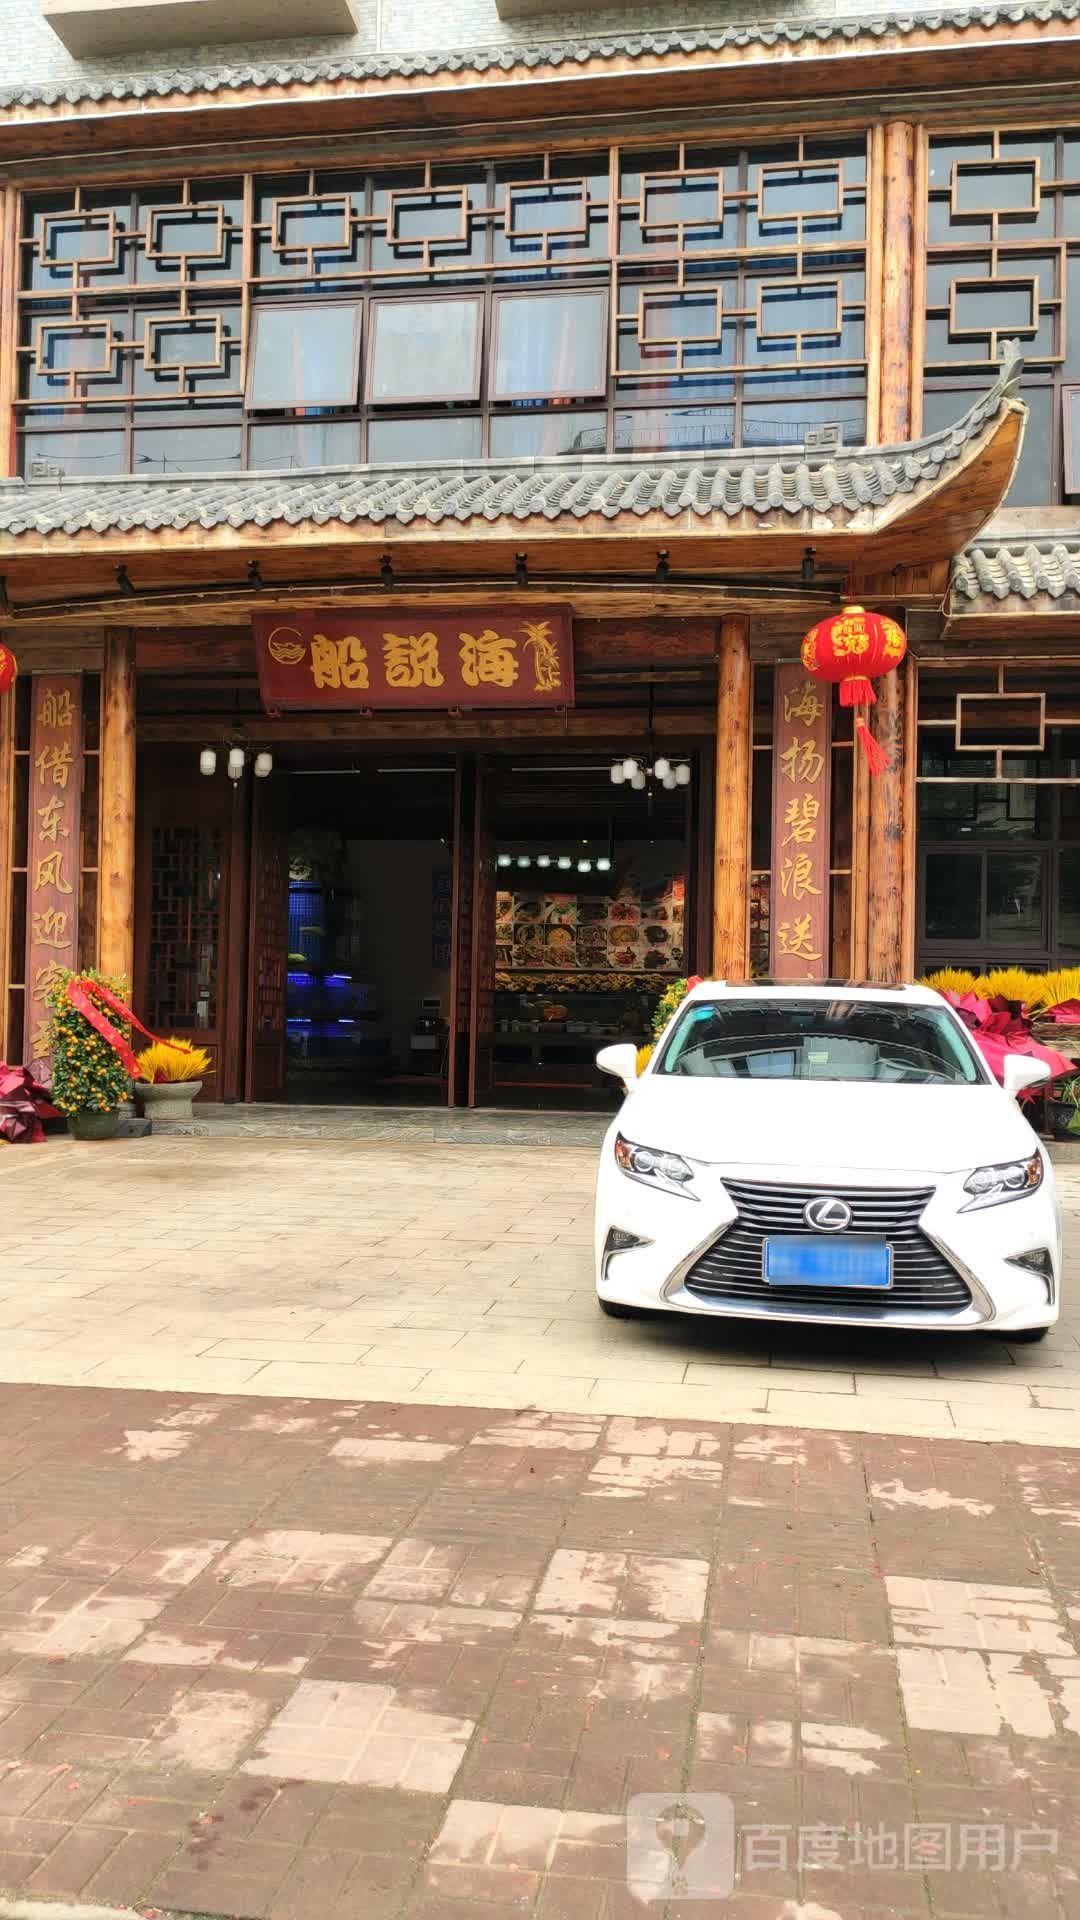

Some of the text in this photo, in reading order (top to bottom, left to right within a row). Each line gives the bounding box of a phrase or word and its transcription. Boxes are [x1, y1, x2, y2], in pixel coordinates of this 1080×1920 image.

[777, 680, 823, 979] 海扬碧浪送
